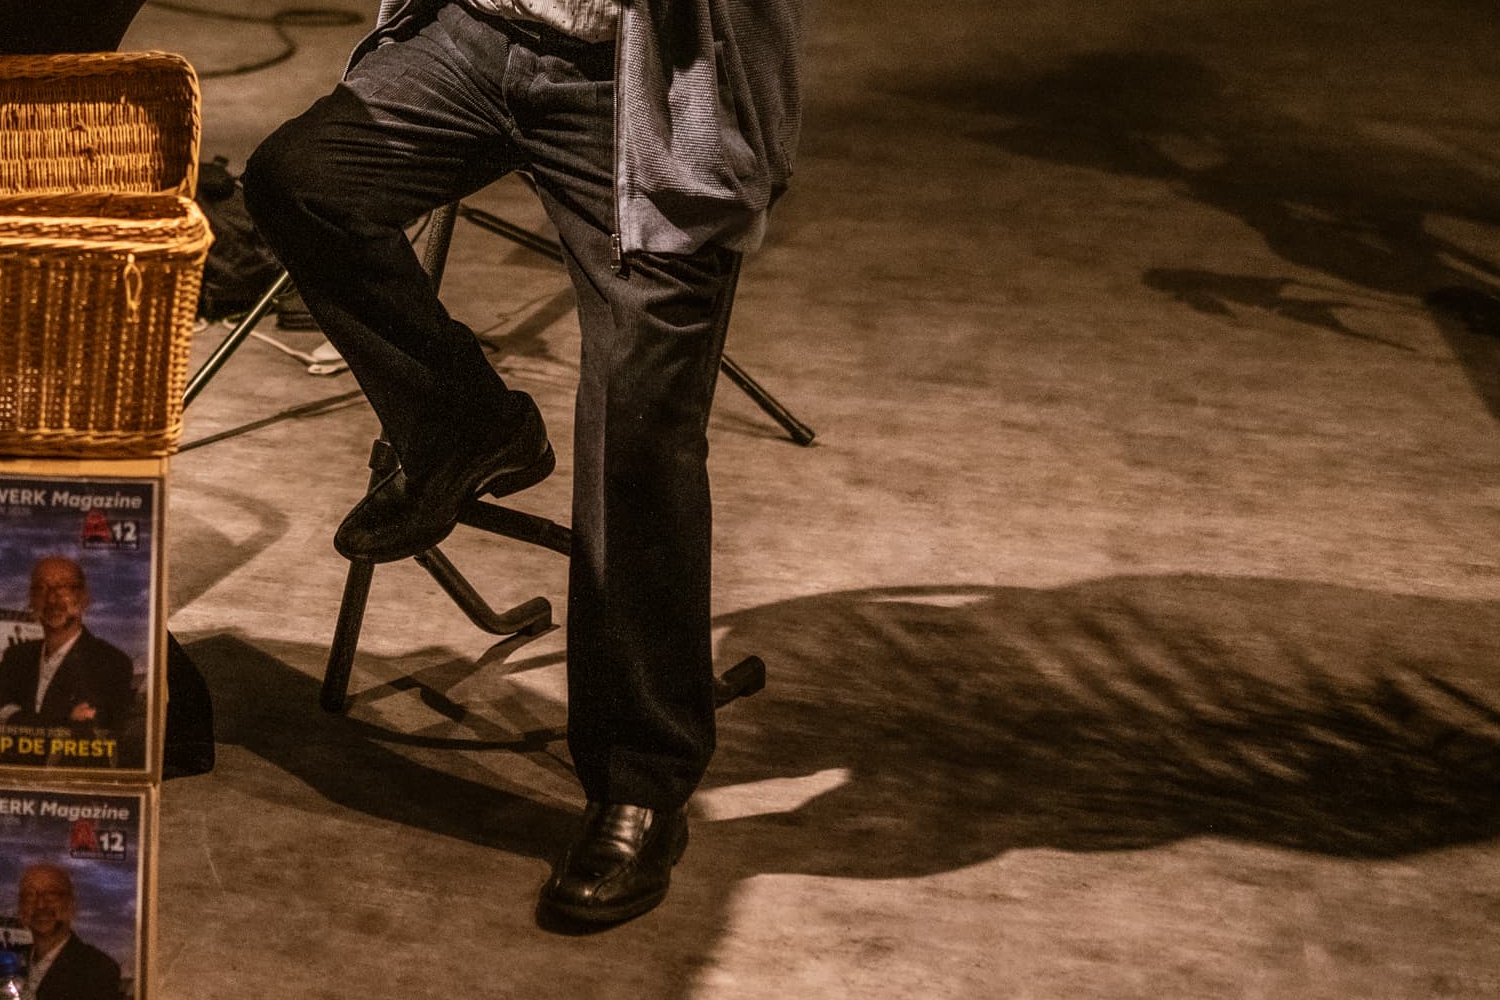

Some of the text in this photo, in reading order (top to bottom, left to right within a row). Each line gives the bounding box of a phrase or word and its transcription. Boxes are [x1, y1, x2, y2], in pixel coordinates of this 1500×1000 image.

[51, 491, 143, 512] Magazine
[18, 738, 45, 755] DE
[50, 739, 117, 758] PREST
[40, 801, 130, 821] Magazine
